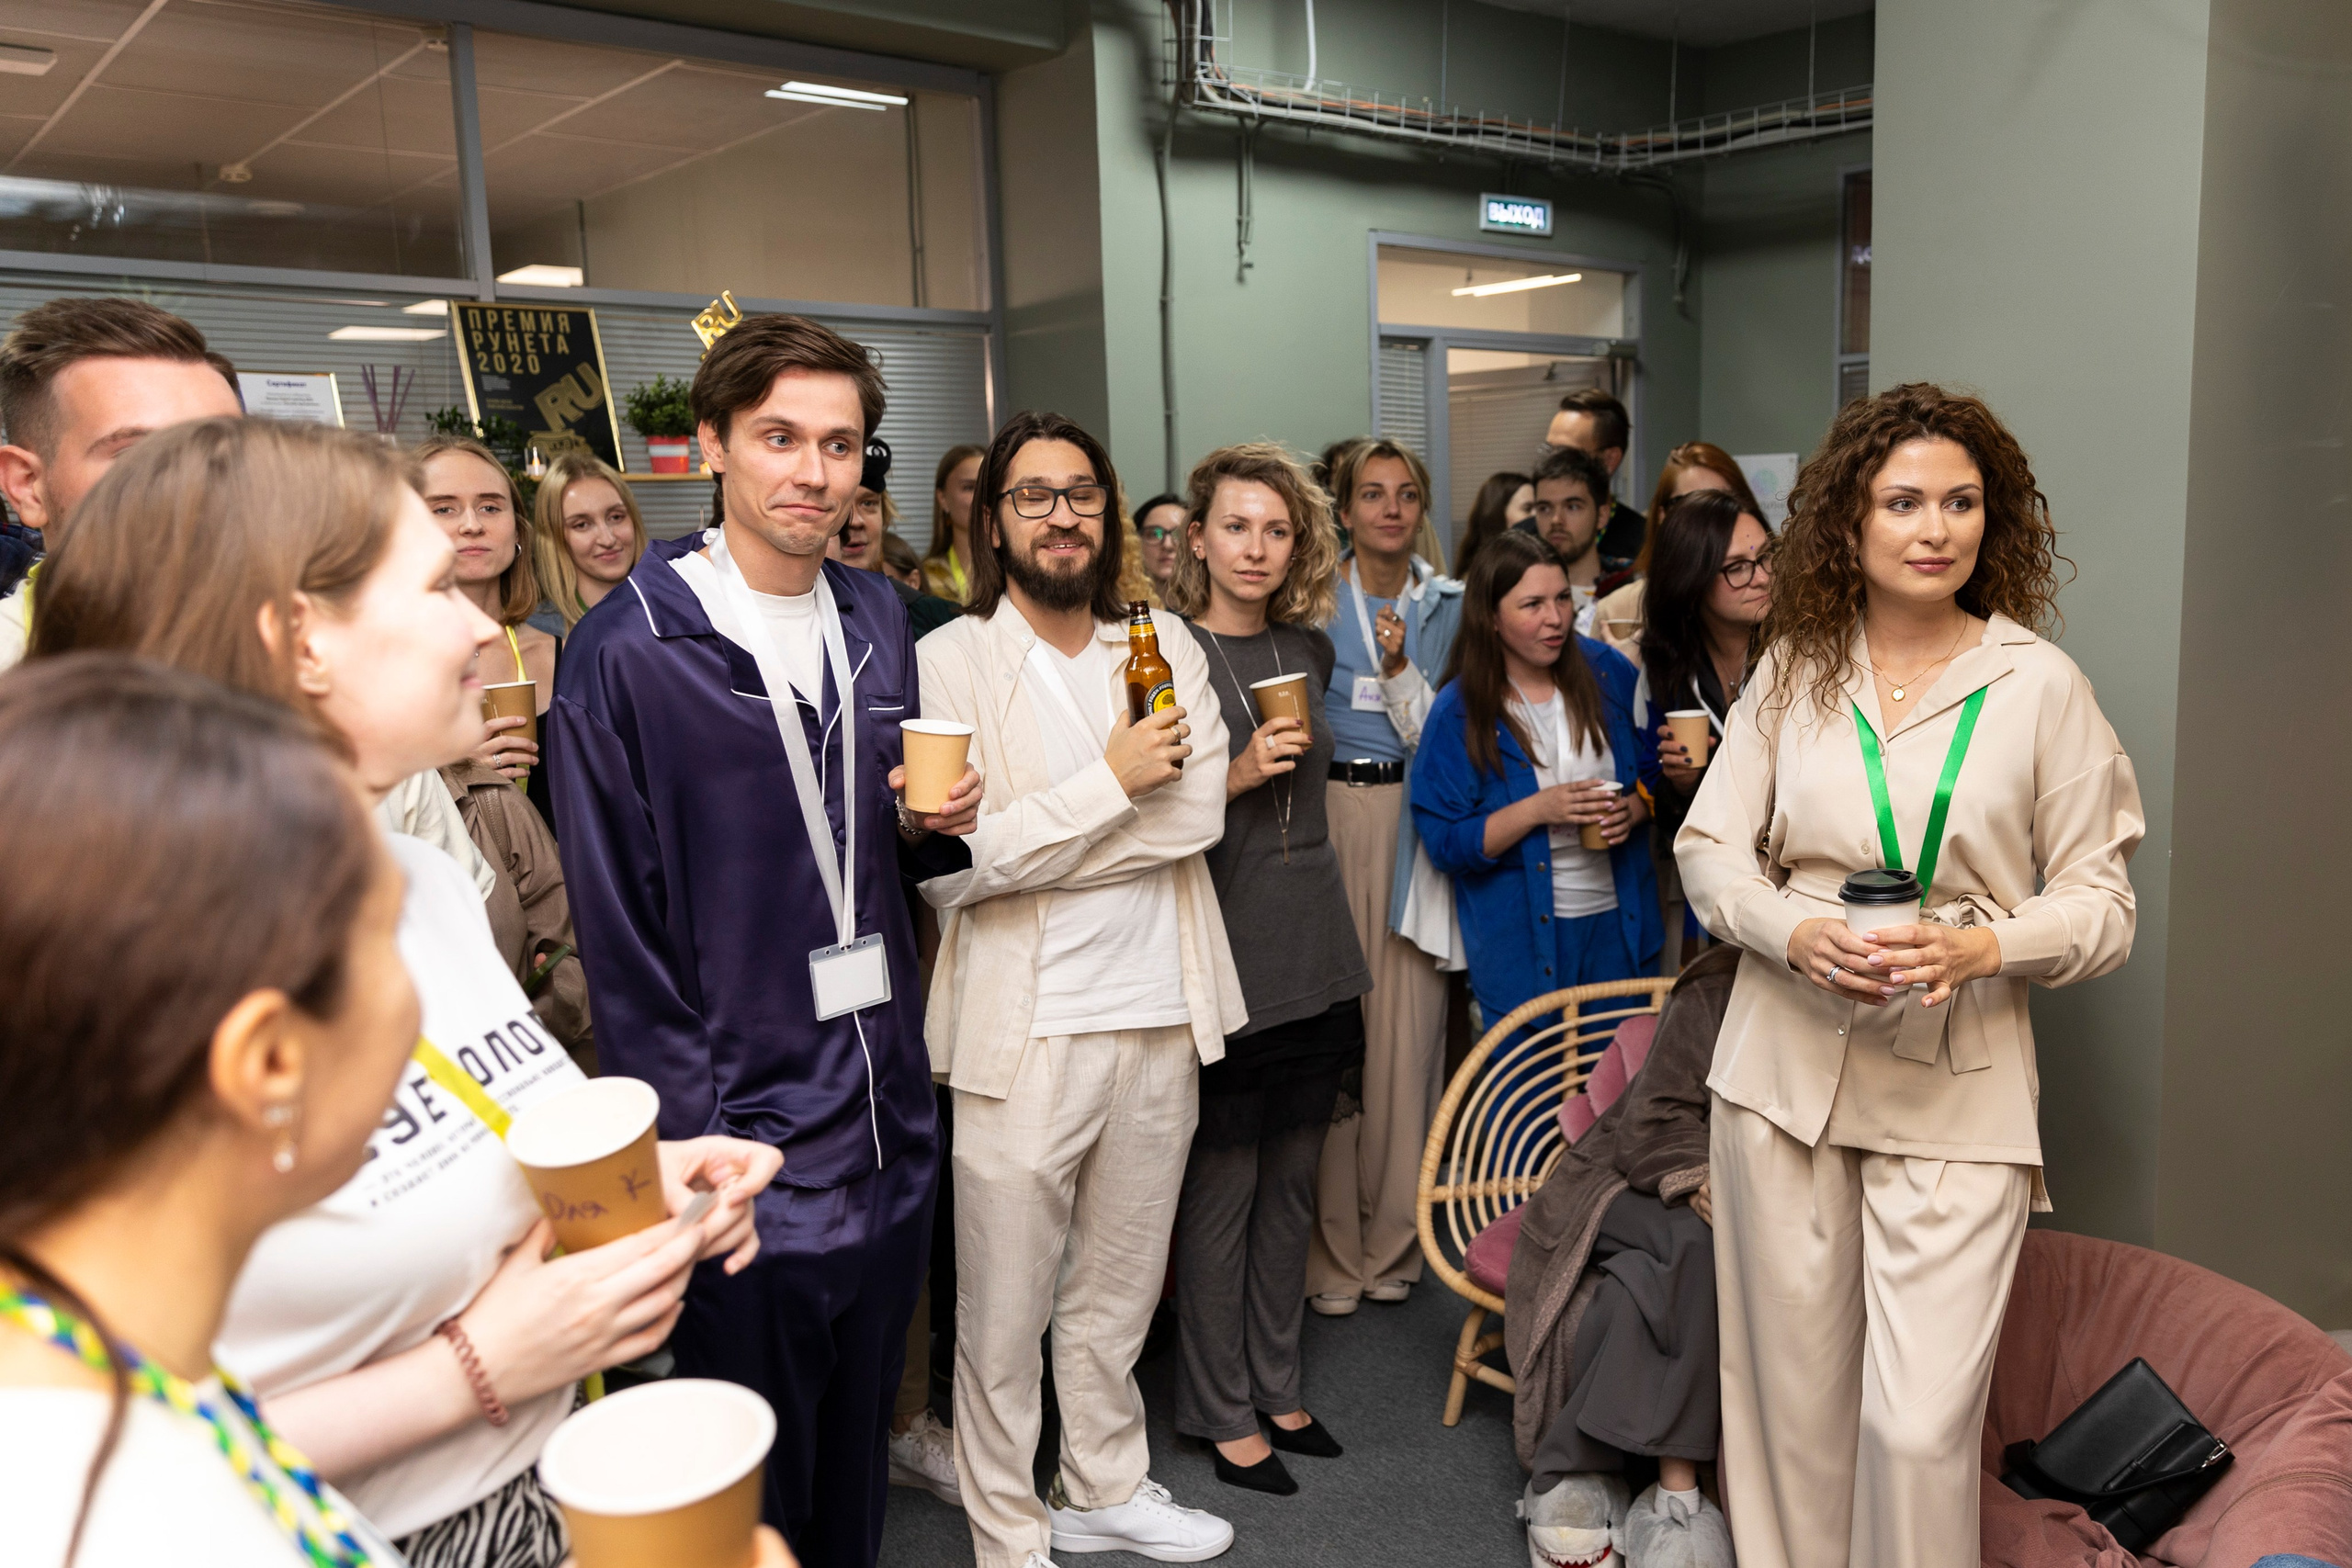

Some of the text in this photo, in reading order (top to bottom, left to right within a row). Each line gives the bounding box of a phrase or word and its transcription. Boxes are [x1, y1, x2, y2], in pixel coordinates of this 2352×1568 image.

[1488, 201, 1544, 230] ВЫХОД
[468, 309, 571, 333] ПРЕМИЯ
[471, 331, 569, 355] РУНЕТА
[476, 352, 541, 375] 2020
